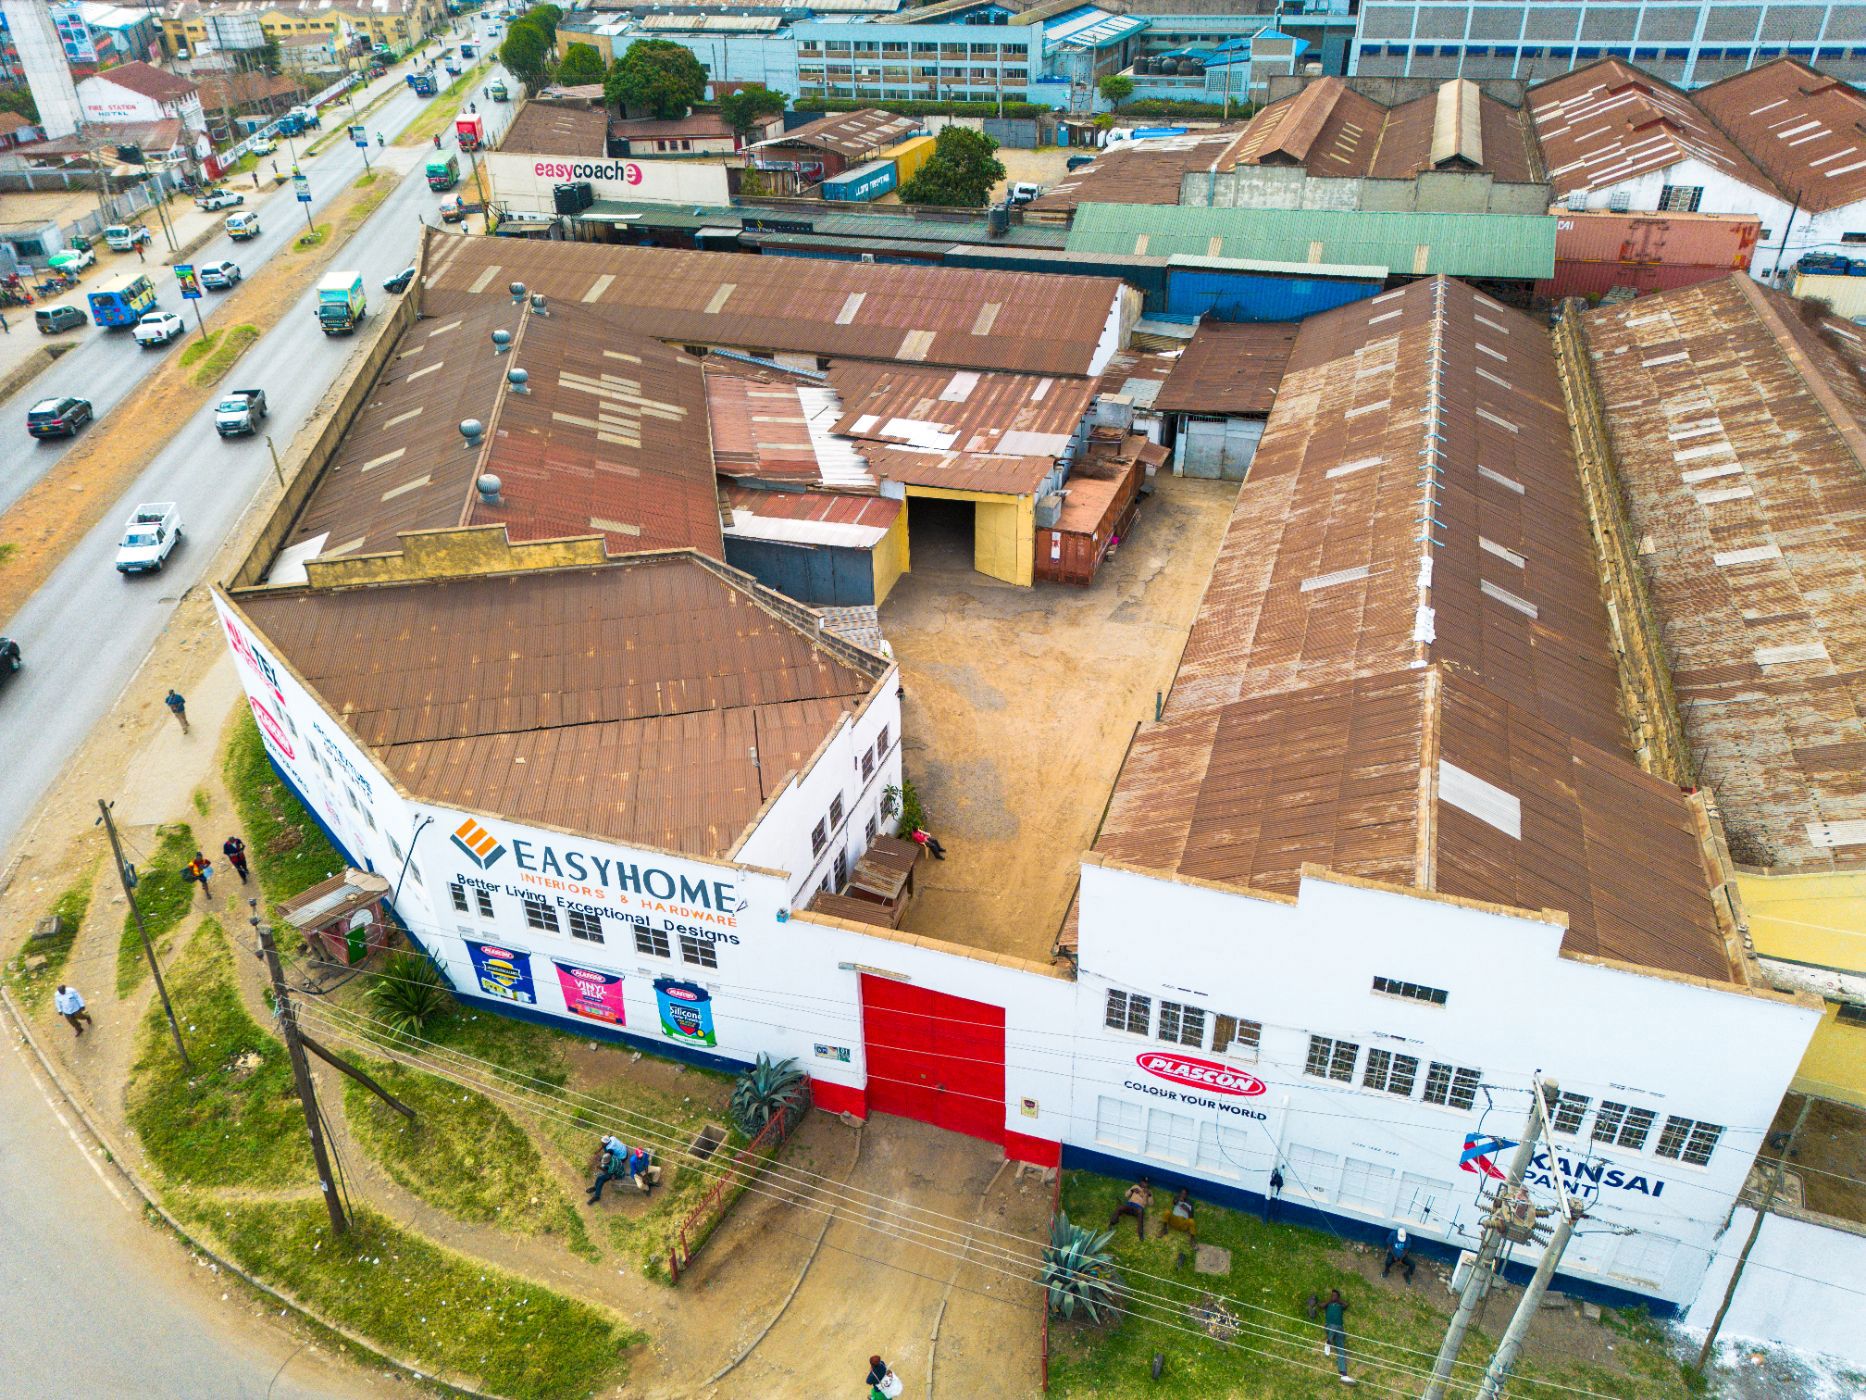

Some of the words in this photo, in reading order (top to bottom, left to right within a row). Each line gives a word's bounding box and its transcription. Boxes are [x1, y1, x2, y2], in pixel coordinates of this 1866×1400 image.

[535, 161, 624, 182] easycoach
[512, 838, 736, 914] EASYHOME
[456, 872, 501, 893] Better
[505, 884, 547, 905] Living
[556, 895, 650, 927] Exceptional
[664, 919, 741, 945] Designs
[520, 872, 606, 899] INTERIORS
[620, 894, 629, 904] &
[641, 899, 737, 928] HARDWARE
[574, 979, 607, 995] VINYL
[581, 989, 604, 1000] SILK
[1147, 1057, 1255, 1091] PLASCON
[1124, 1080, 1178, 1100] COLOUR
[1180, 1093, 1216, 1109] YOUR
[1218, 1102, 1267, 1121] WORLD
[1523, 1170, 1598, 1198] PANT
[1527, 1150, 1665, 1197] KANSAI
